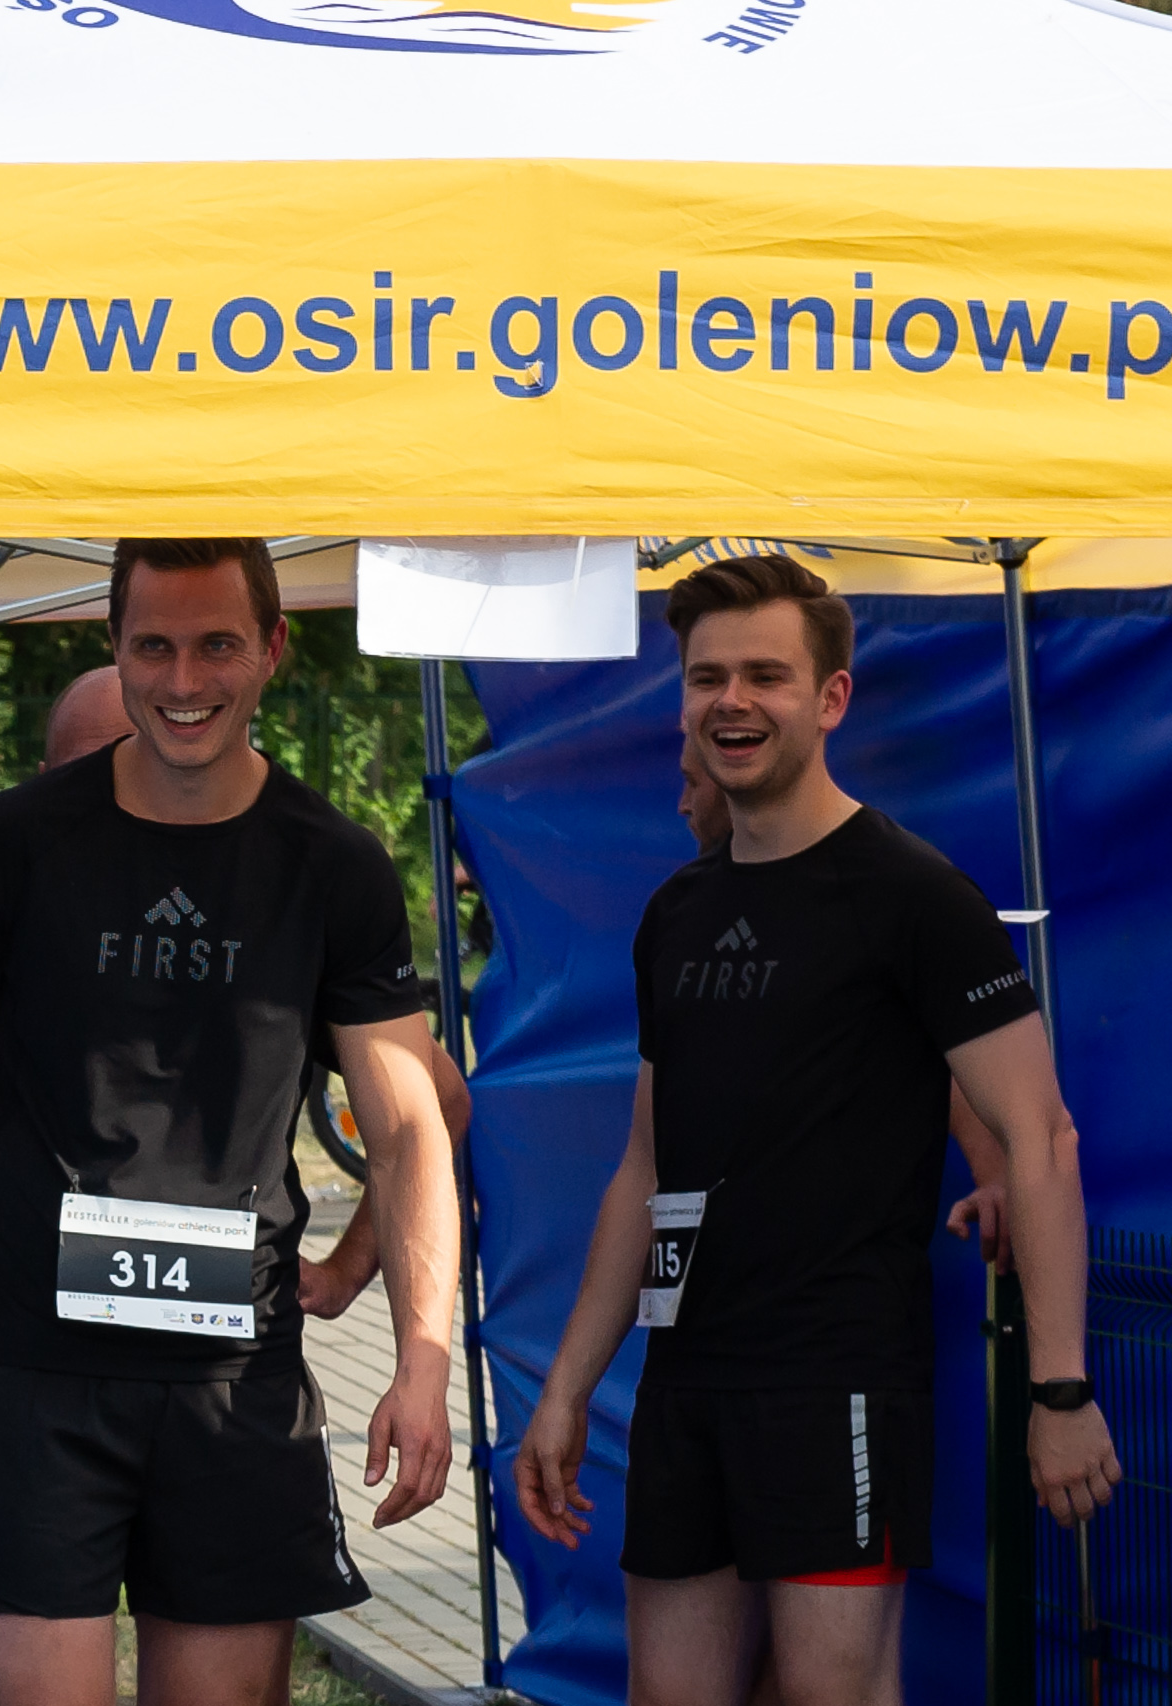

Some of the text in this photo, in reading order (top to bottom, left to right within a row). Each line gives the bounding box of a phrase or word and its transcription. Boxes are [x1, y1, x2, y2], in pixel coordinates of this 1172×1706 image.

[98, 932, 242, 983] FIRST
[674, 960, 779, 999] FIRST
[68, 1211, 129, 1225] BESTSELLER
[178, 1222, 221, 1234] athletics
[225, 1226, 249, 1236] park
[109, 1250, 190, 1292] 314
